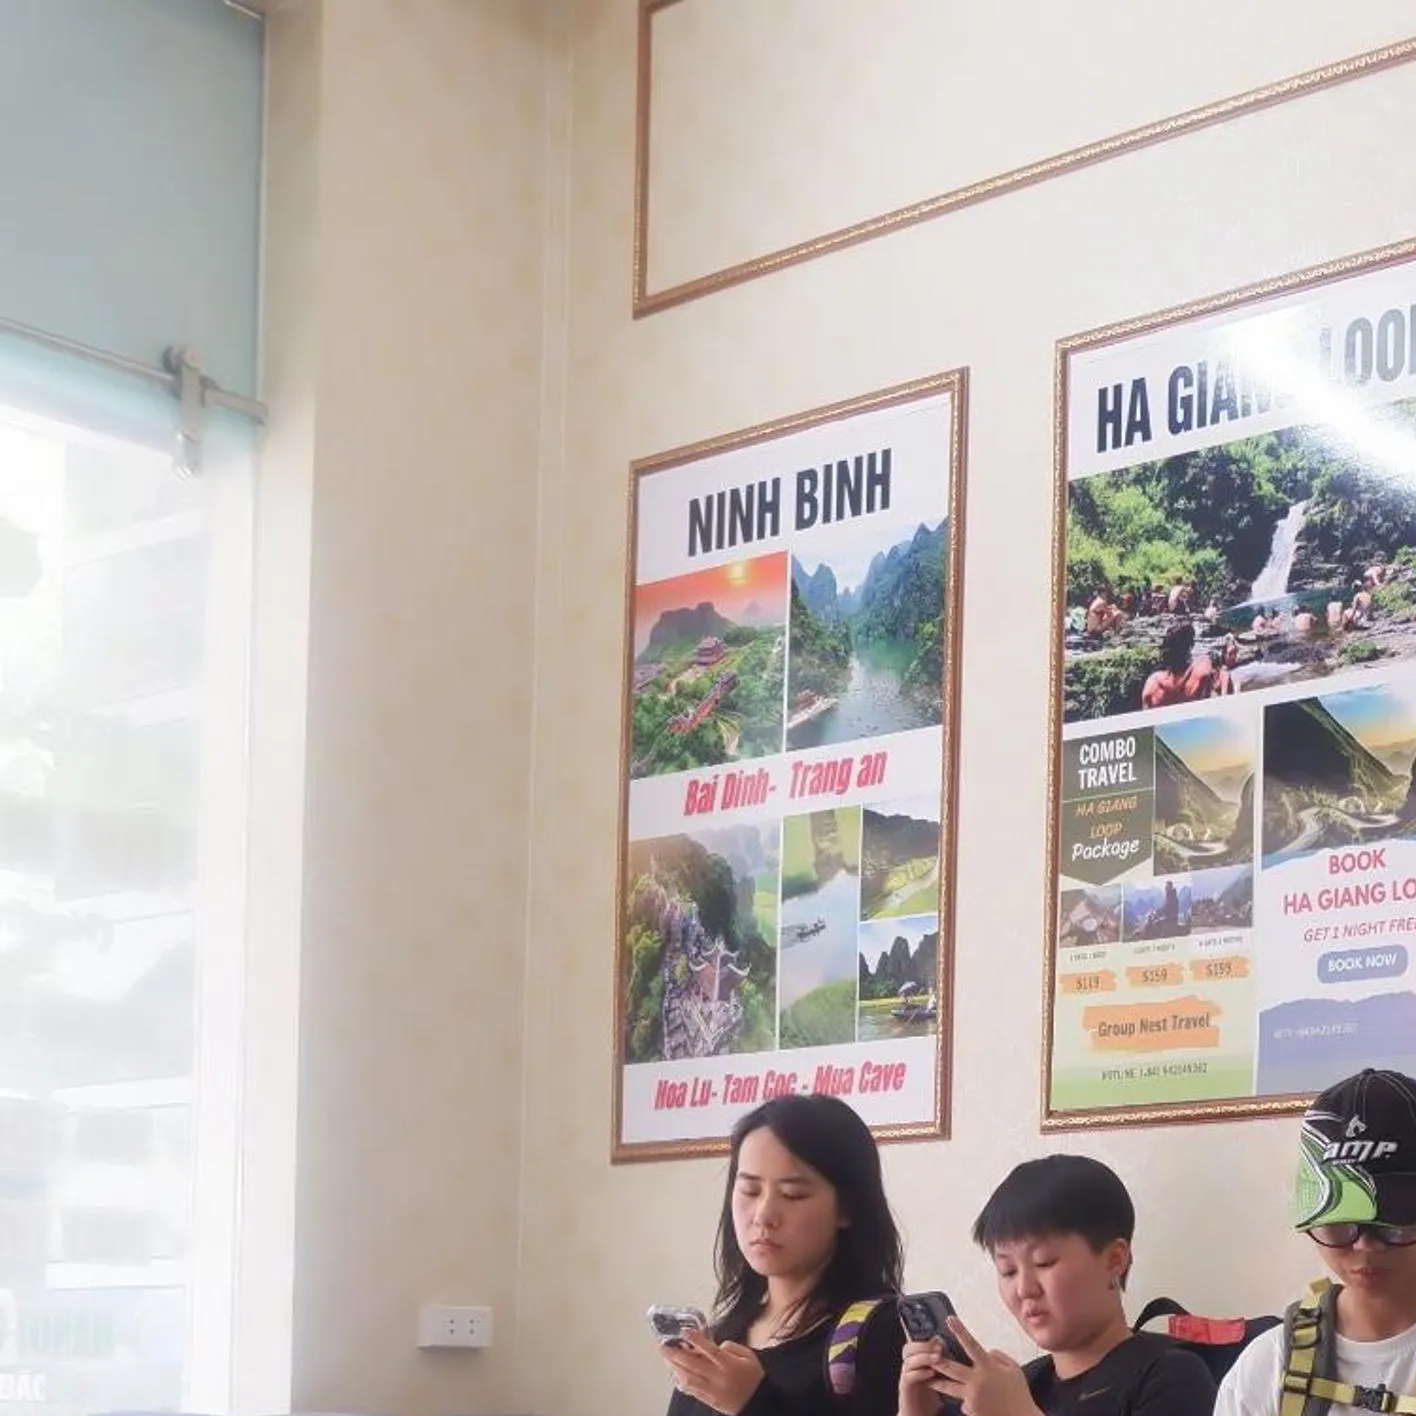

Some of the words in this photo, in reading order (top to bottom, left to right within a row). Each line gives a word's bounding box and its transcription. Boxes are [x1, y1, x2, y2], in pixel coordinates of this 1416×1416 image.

[1096, 377, 1153, 454] HA
[688, 477, 781, 557] NINH
[795, 447, 892, 531] BINH
[1080, 736, 1136, 765] COMBO
[683, 774, 720, 816] Bai
[789, 757, 853, 799] Trang
[856, 751, 888, 788] an
[1078, 761, 1138, 789] TRAVEL
[1072, 837, 1140, 861] Package
[1328, 848, 1386, 875] BOOK
[1283, 892, 1313, 915] HA
[1318, 881, 1386, 910] GIANG
[1303, 926, 1331, 942] GET
[1342, 920, 1387, 938] NIGHT
[1328, 956, 1363, 972] BOOK
[1366, 952, 1398, 968] NOW
[1098, 1020, 1135, 1038] Group
[1139, 1017, 1168, 1033] Nest
[1171, 1012, 1210, 1029] Travel
[654, 1079, 688, 1110] Hoa
[723, 1074, 759, 1105] Tam
[814, 1065, 854, 1096] Mua
[859, 1061, 907, 1094] Cave
